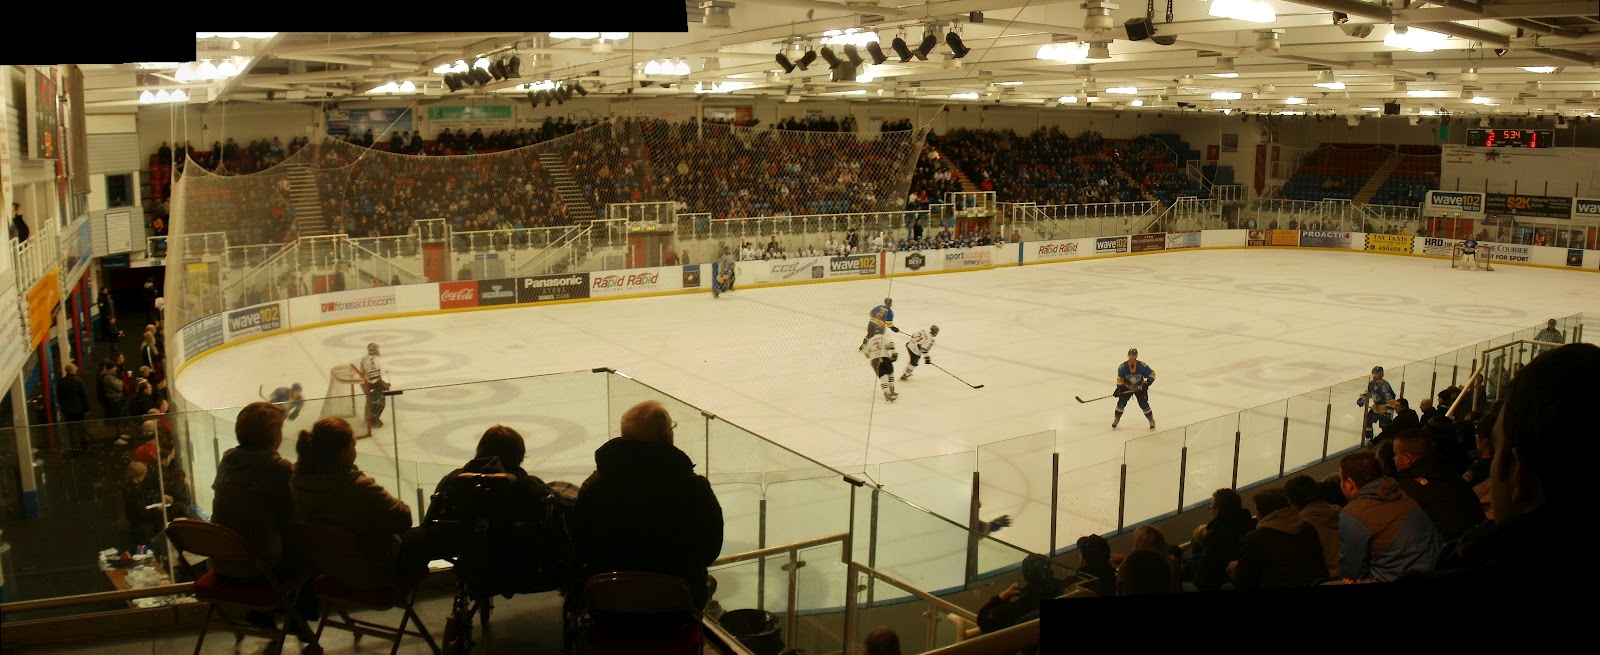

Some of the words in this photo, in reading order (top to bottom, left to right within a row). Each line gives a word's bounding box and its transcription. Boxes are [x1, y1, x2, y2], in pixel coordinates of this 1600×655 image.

[1433, 195, 1480, 206] wave102
[1507, 197, 1532, 209] S2K
[1097, 238, 1127, 250] wave102
[1425, 238, 1443, 246] HRD
[1497, 244, 1529, 254] COURIER
[831, 257, 876, 271] wave102
[524, 275, 582, 289] Panasonic
[592, 274, 626, 289] Rapid
[627, 272, 659, 286] Rapid
[229, 306, 279, 330] wave102
